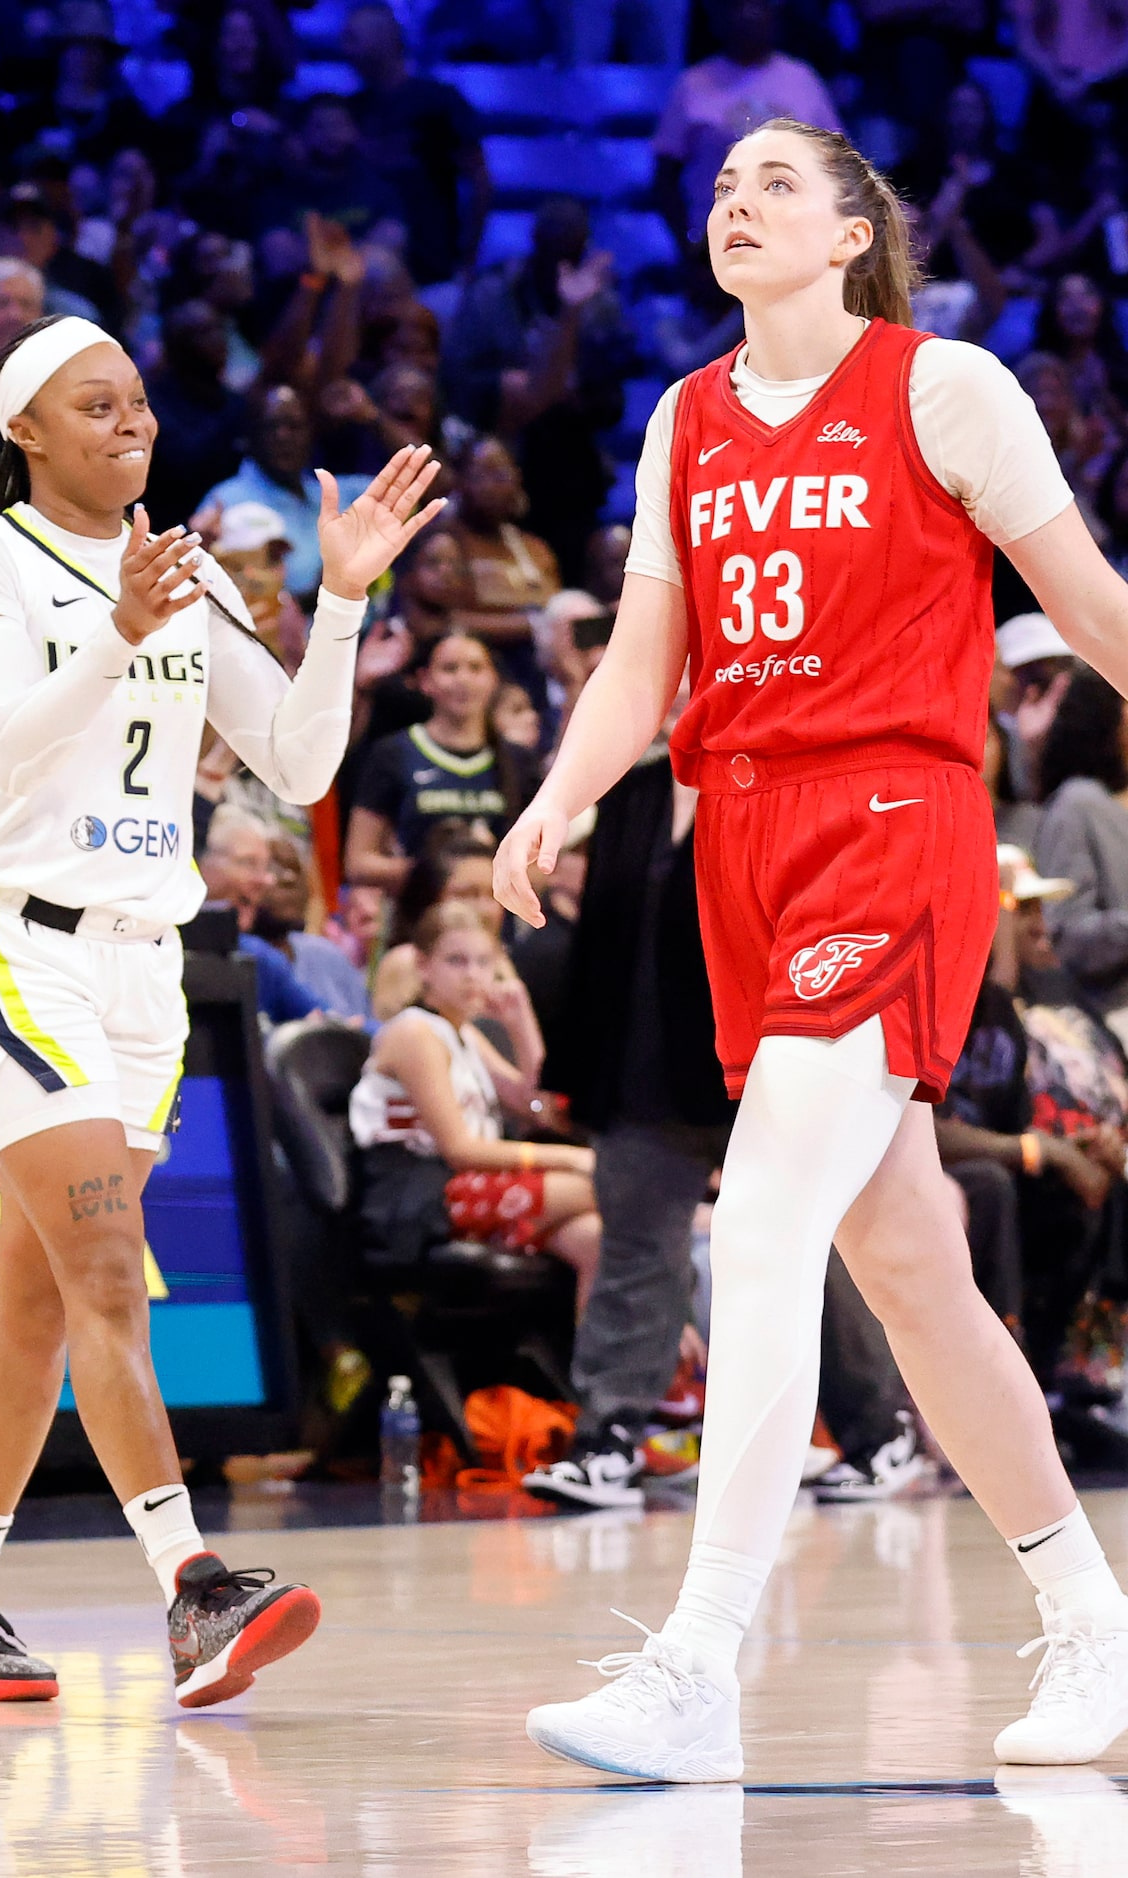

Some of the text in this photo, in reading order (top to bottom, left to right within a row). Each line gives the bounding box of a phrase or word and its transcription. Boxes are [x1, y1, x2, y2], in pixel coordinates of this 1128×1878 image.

[816, 420, 868, 449] Lilly
[690, 474, 872, 548] FEVER
[720, 550, 805, 645] 33
[44, 638, 205, 686] NGS
[128, 690, 202, 706] LLAS
[122, 718, 152, 798] 2
[113, 817, 180, 861] GEM
